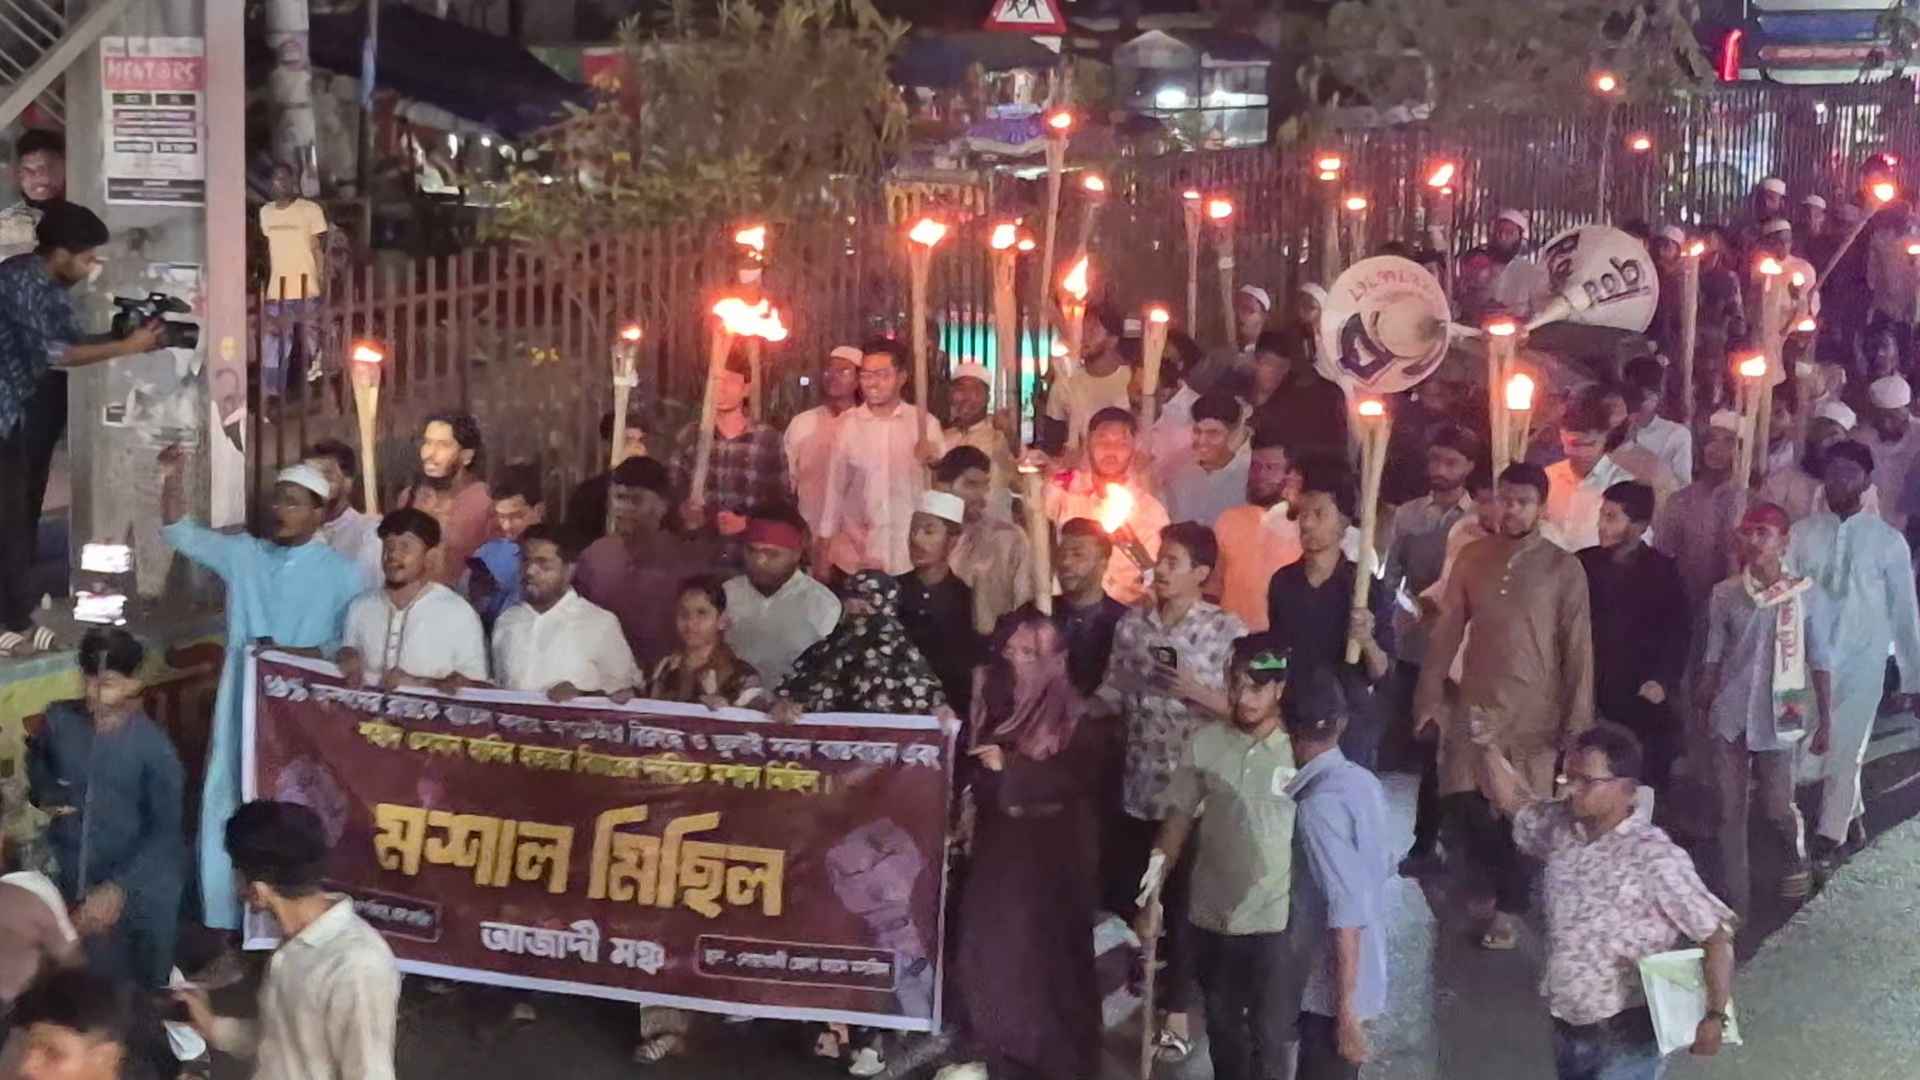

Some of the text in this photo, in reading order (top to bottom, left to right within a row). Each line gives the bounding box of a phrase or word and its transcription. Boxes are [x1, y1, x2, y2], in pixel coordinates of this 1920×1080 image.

[373, 802, 786, 919] মশাল মিছিল
[479, 918, 600, 963] আজাদী
[608, 936, 666, 976] মঞ্চ
